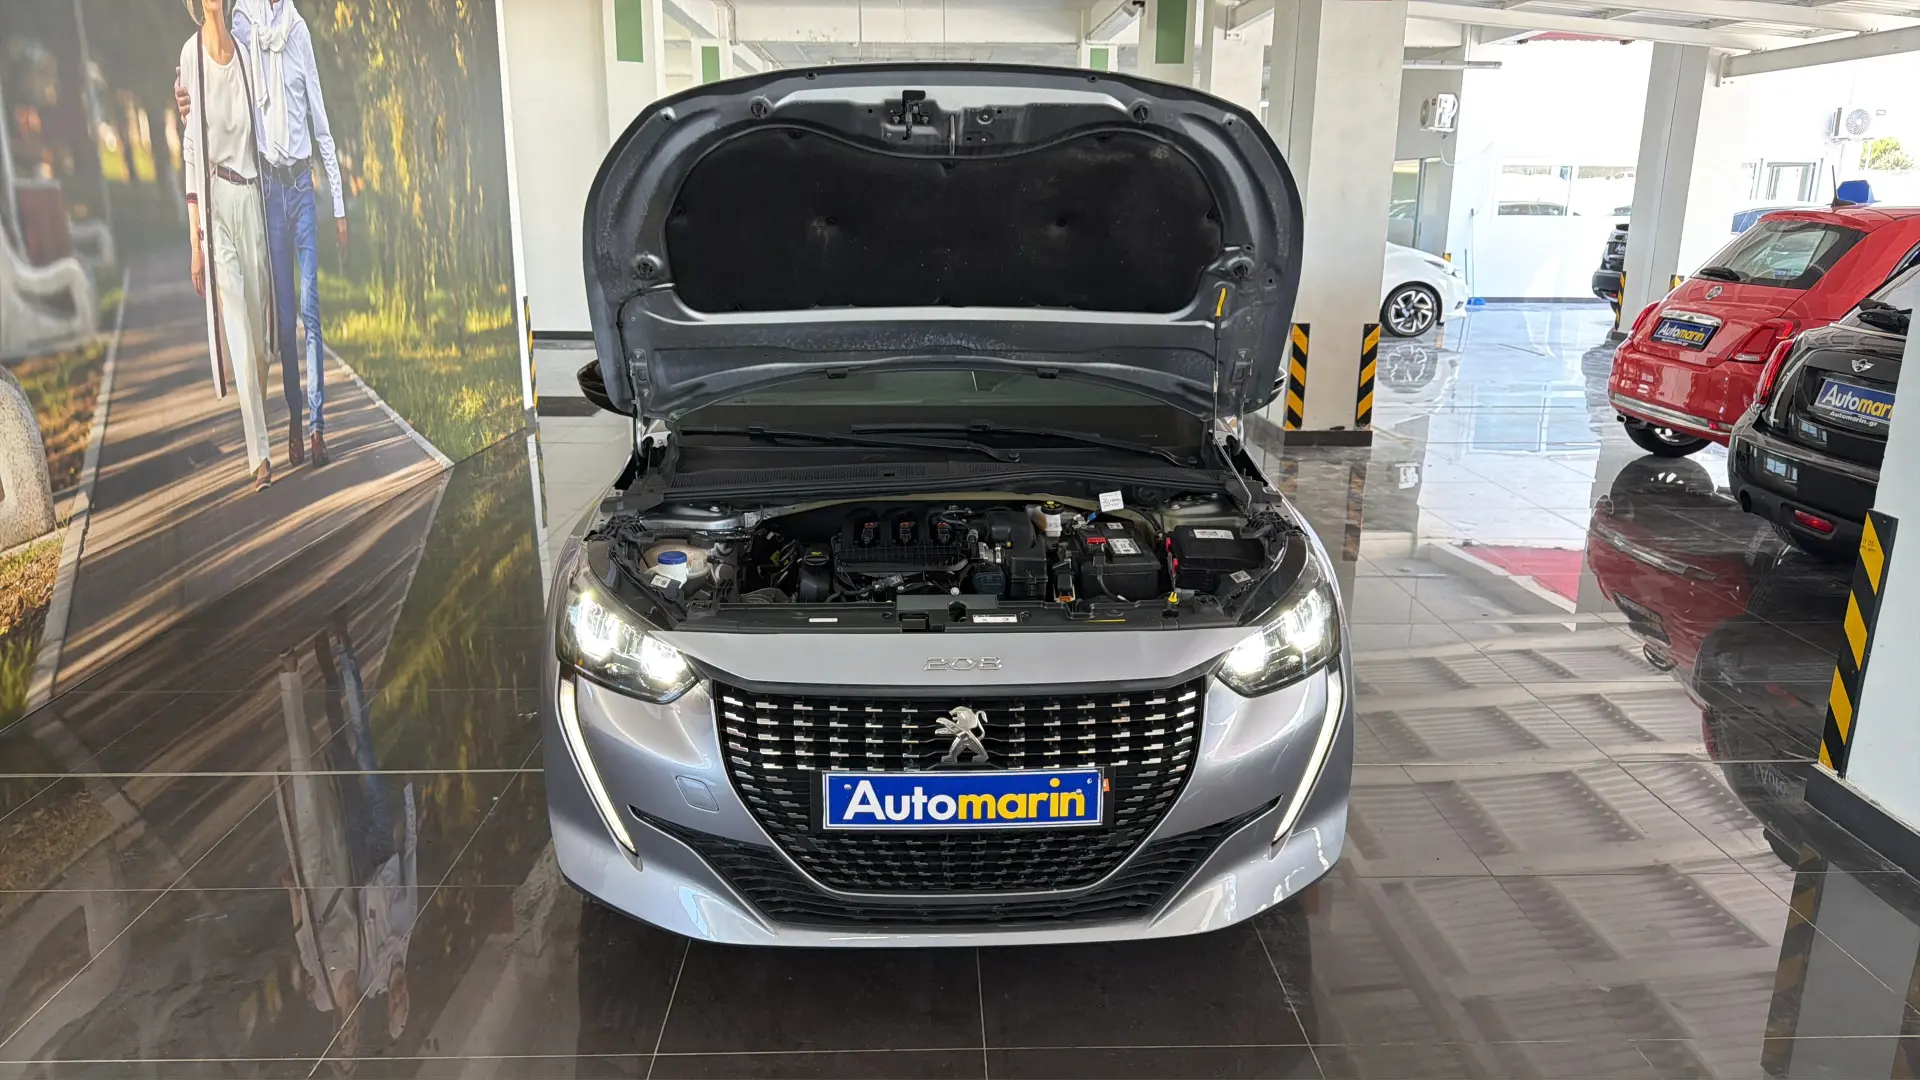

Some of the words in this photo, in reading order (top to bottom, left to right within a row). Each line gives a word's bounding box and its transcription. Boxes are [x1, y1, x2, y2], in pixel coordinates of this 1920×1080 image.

[1657, 321, 1705, 342] Automarin
[1822, 384, 1893, 419] Automar
[1829, 411, 1878, 427] Automarin.gr
[923, 656, 1002, 671] 208
[843, 777, 1085, 820] Automarin
